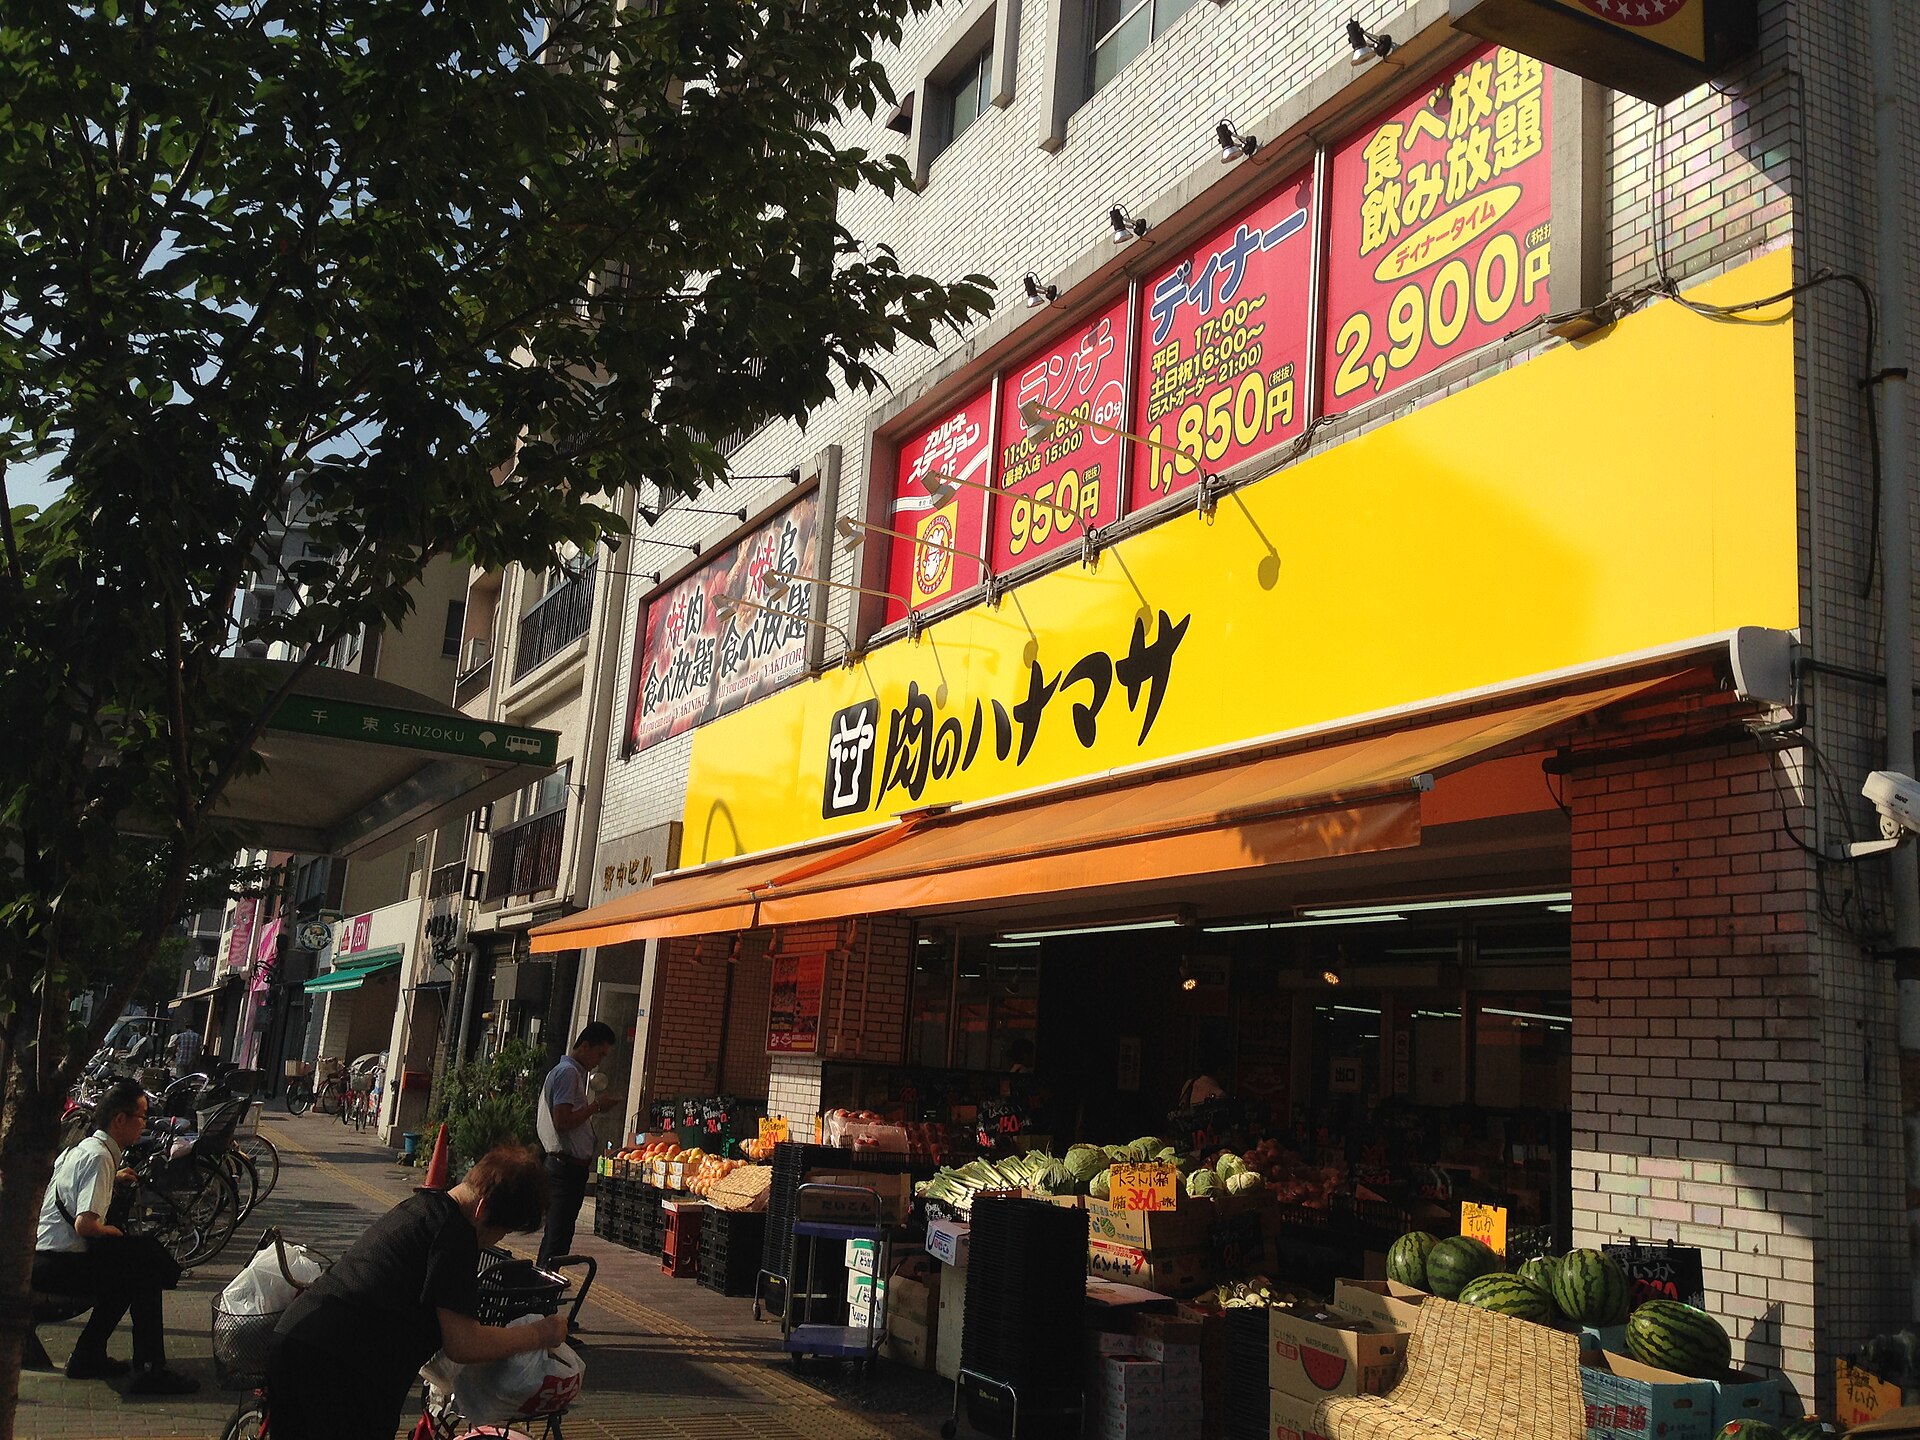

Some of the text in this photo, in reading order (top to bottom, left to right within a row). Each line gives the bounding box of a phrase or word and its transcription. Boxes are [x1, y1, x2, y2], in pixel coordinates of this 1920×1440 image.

[1362, 45, 1543, 195] 食べ放題
[1360, 89, 1543, 256] 飲み放題
[1394, 200, 1497, 273] ディナータイム
[1150, 208, 1308, 345] ディナー
[1017, 317, 1114, 432] ランチ
[1152, 341, 1180, 373] 平日
[924, 412, 967, 455] カルネ
[1094, 400, 1122, 425] 60分
[906, 422, 980, 485] ステーション
[1010, 469, 1100, 555] 950円
[666, 585, 704, 648] 焼肉
[721, 583, 810, 679] 食べ放題
[643, 638, 716, 718] 食べ放題
[875, 610, 1191, 812] 肉のハナマサ
[393, 722, 465, 742] SENZOKU
[1335, 1067, 1356, 1083] 出口
